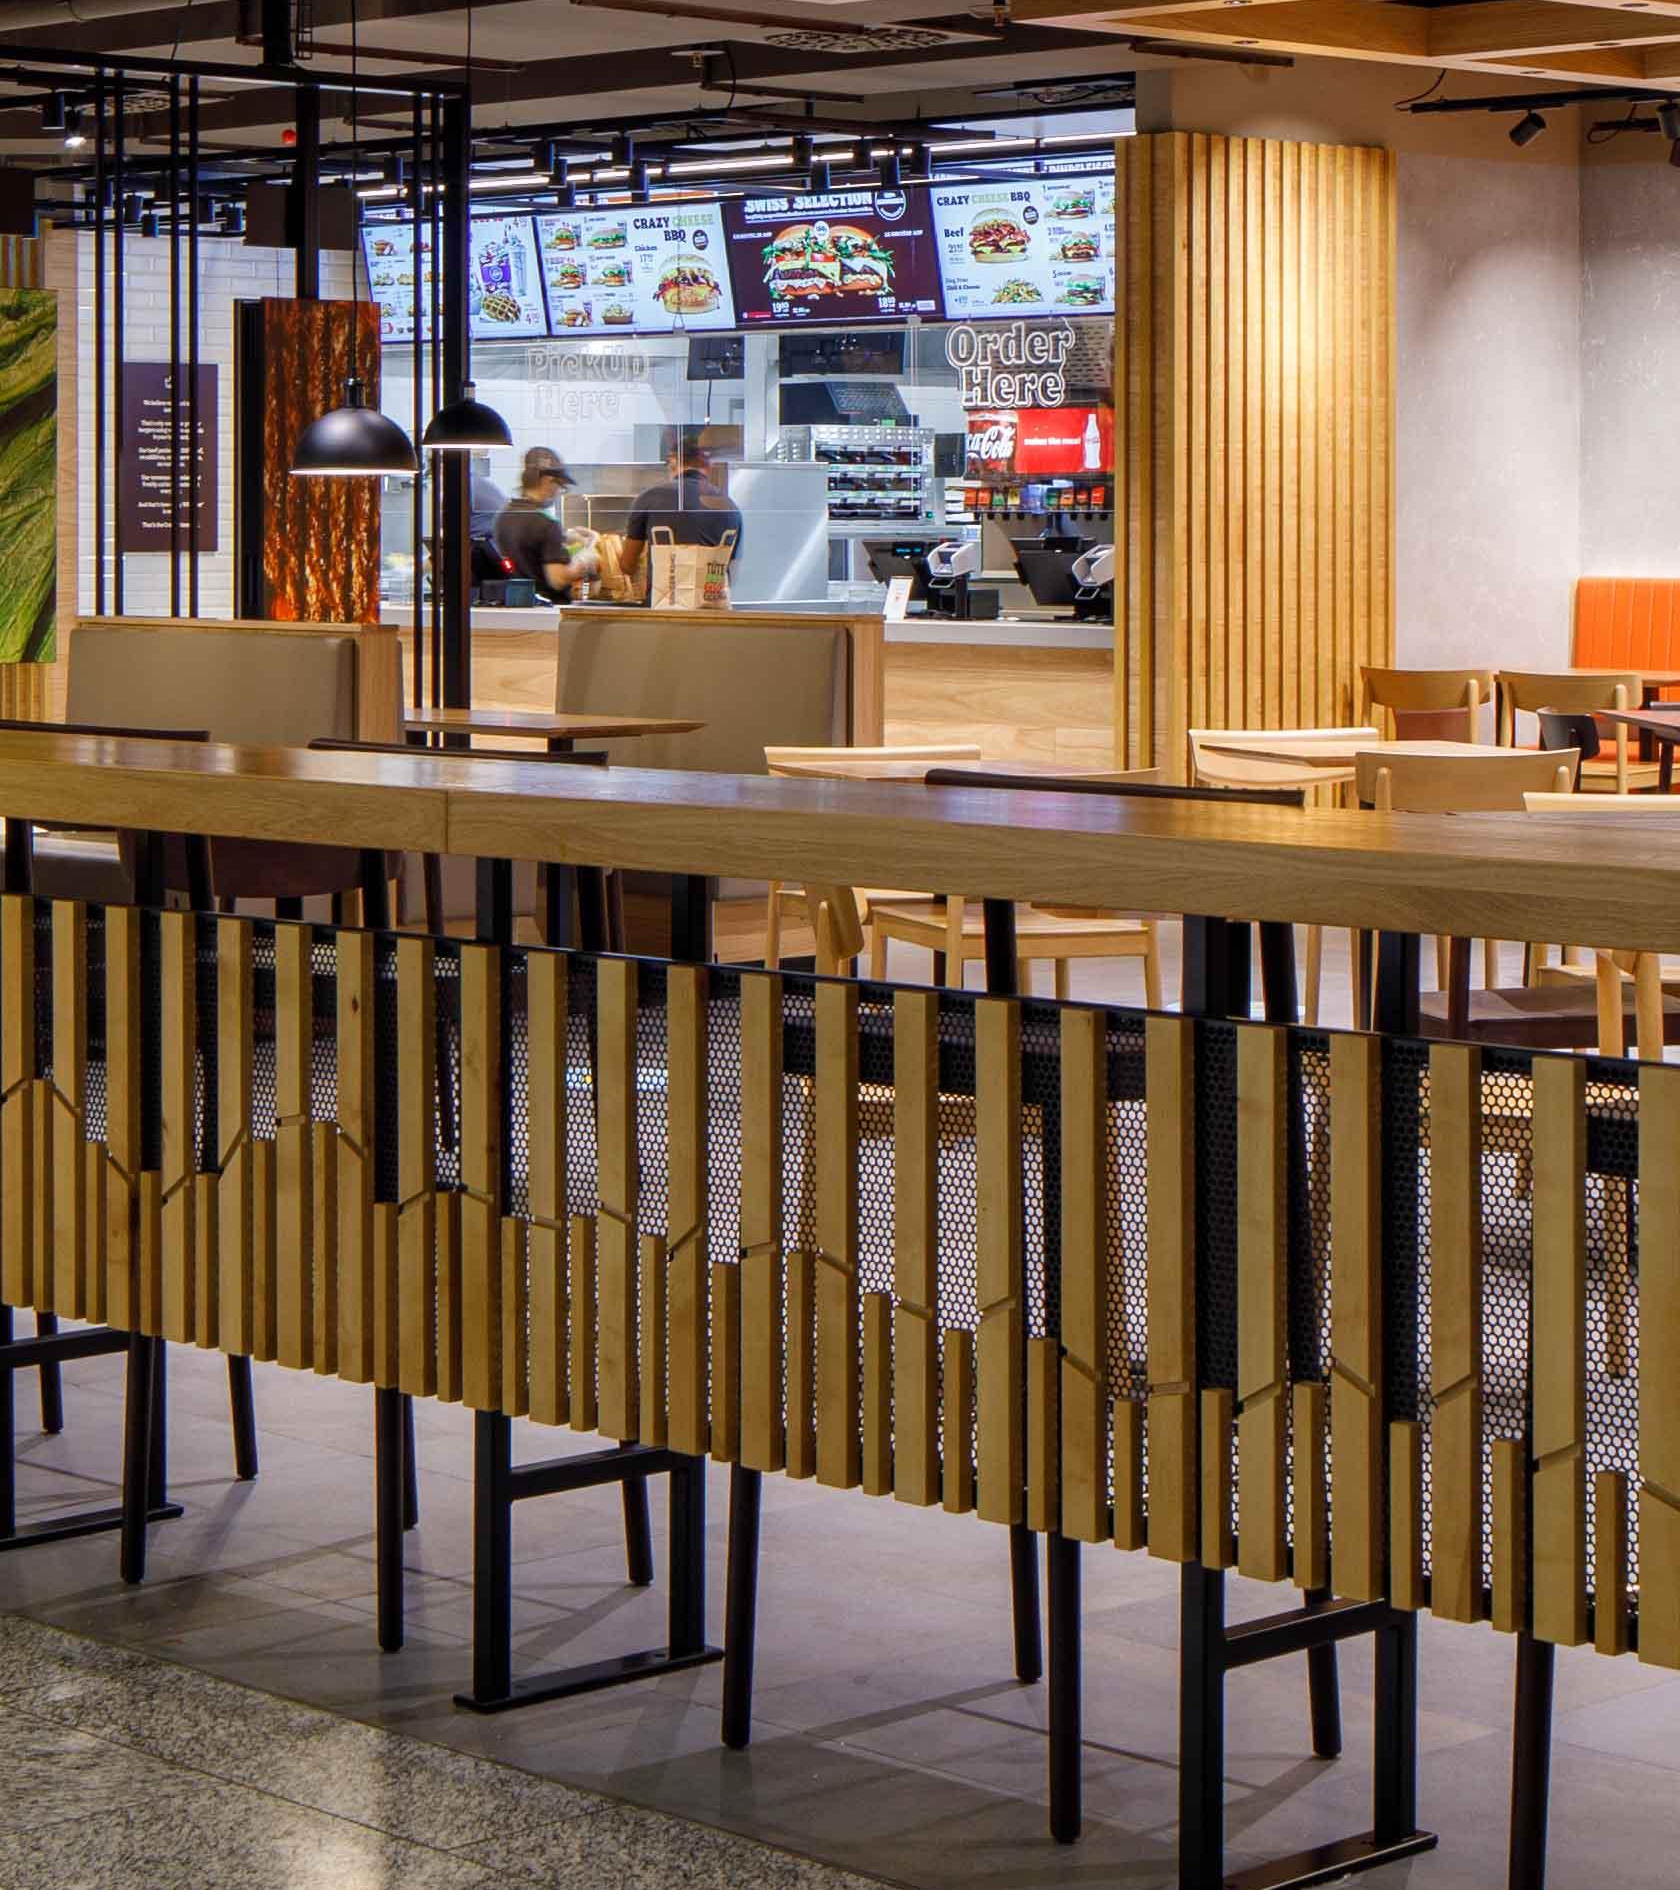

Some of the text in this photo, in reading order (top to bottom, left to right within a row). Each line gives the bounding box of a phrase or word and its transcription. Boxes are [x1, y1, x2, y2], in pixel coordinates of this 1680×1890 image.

[936, 194, 970, 207] CRAZY
[1010, 190, 1031, 203] BBQ
[633, 216, 671, 230] CRAZY
[664, 229, 687, 243] BBQ
[944, 226, 965, 238] Beef
[946, 320, 1076, 367] Order
[961, 365, 1064, 407] Here
